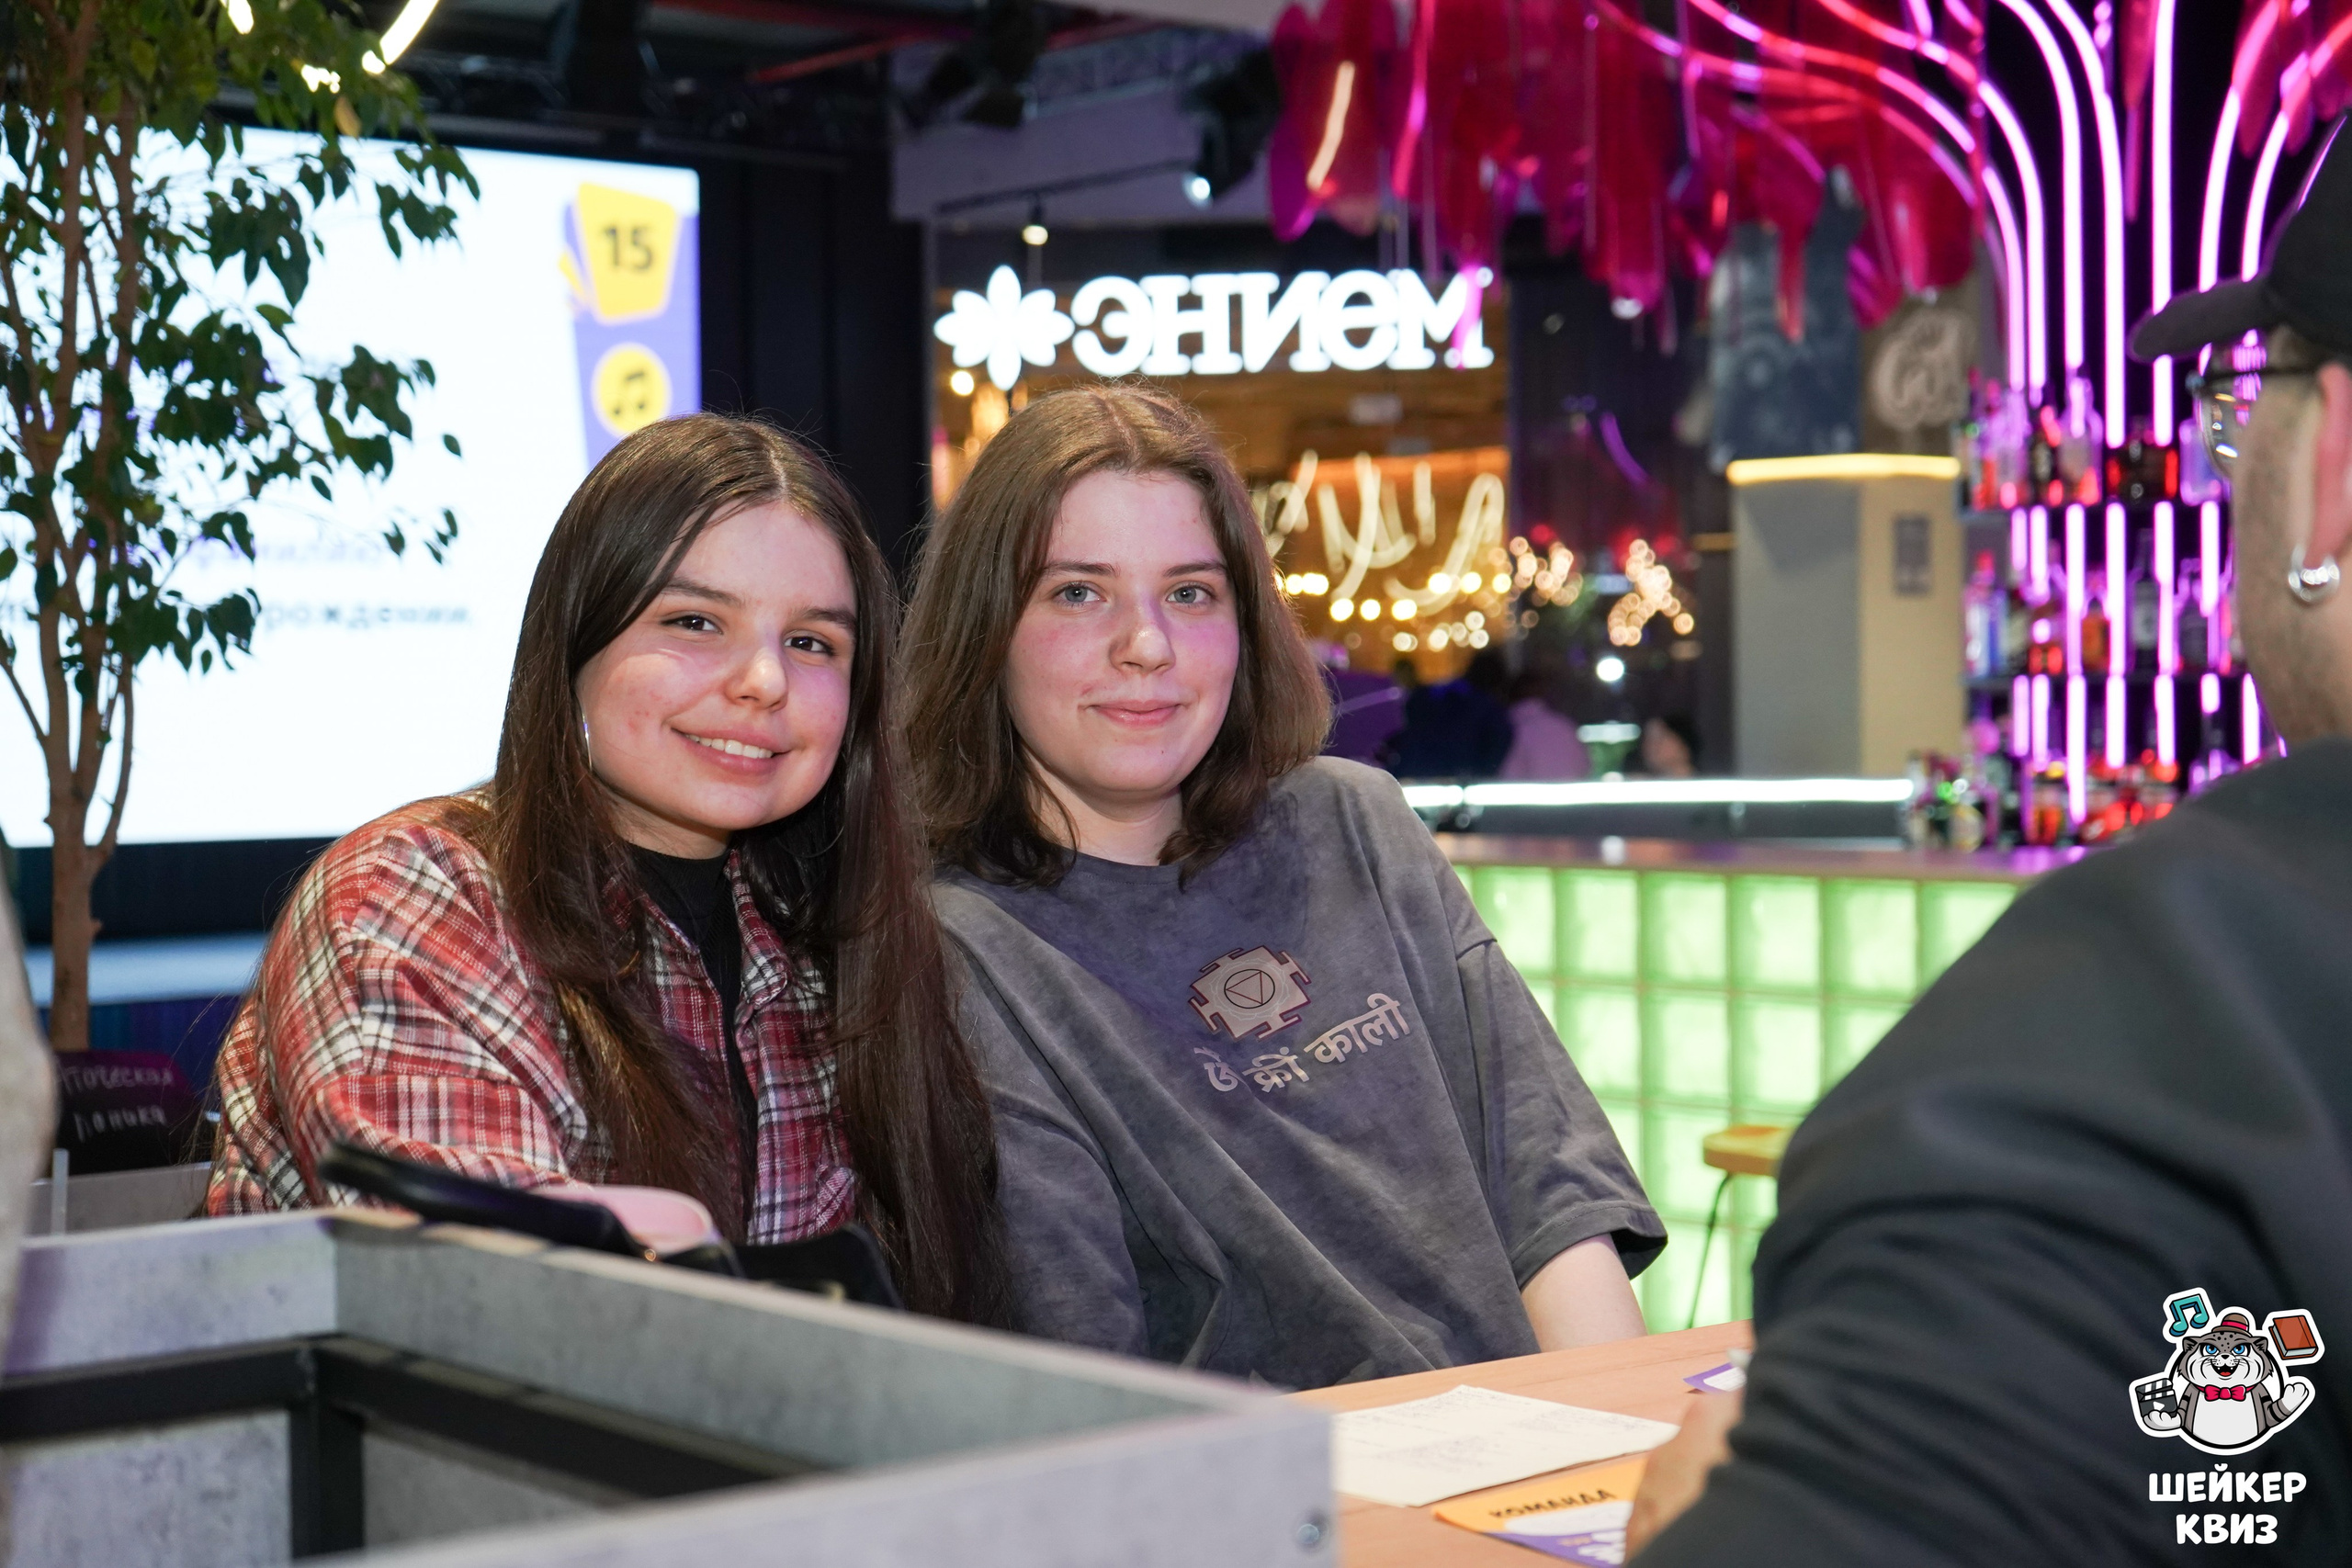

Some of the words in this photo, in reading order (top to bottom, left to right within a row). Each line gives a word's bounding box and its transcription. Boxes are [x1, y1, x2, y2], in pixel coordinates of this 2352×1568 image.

[602, 223, 653, 273] 15
[1303, 993, 1410, 1063] काली
[1489, 1489, 1617, 1517] КОМАНДА
